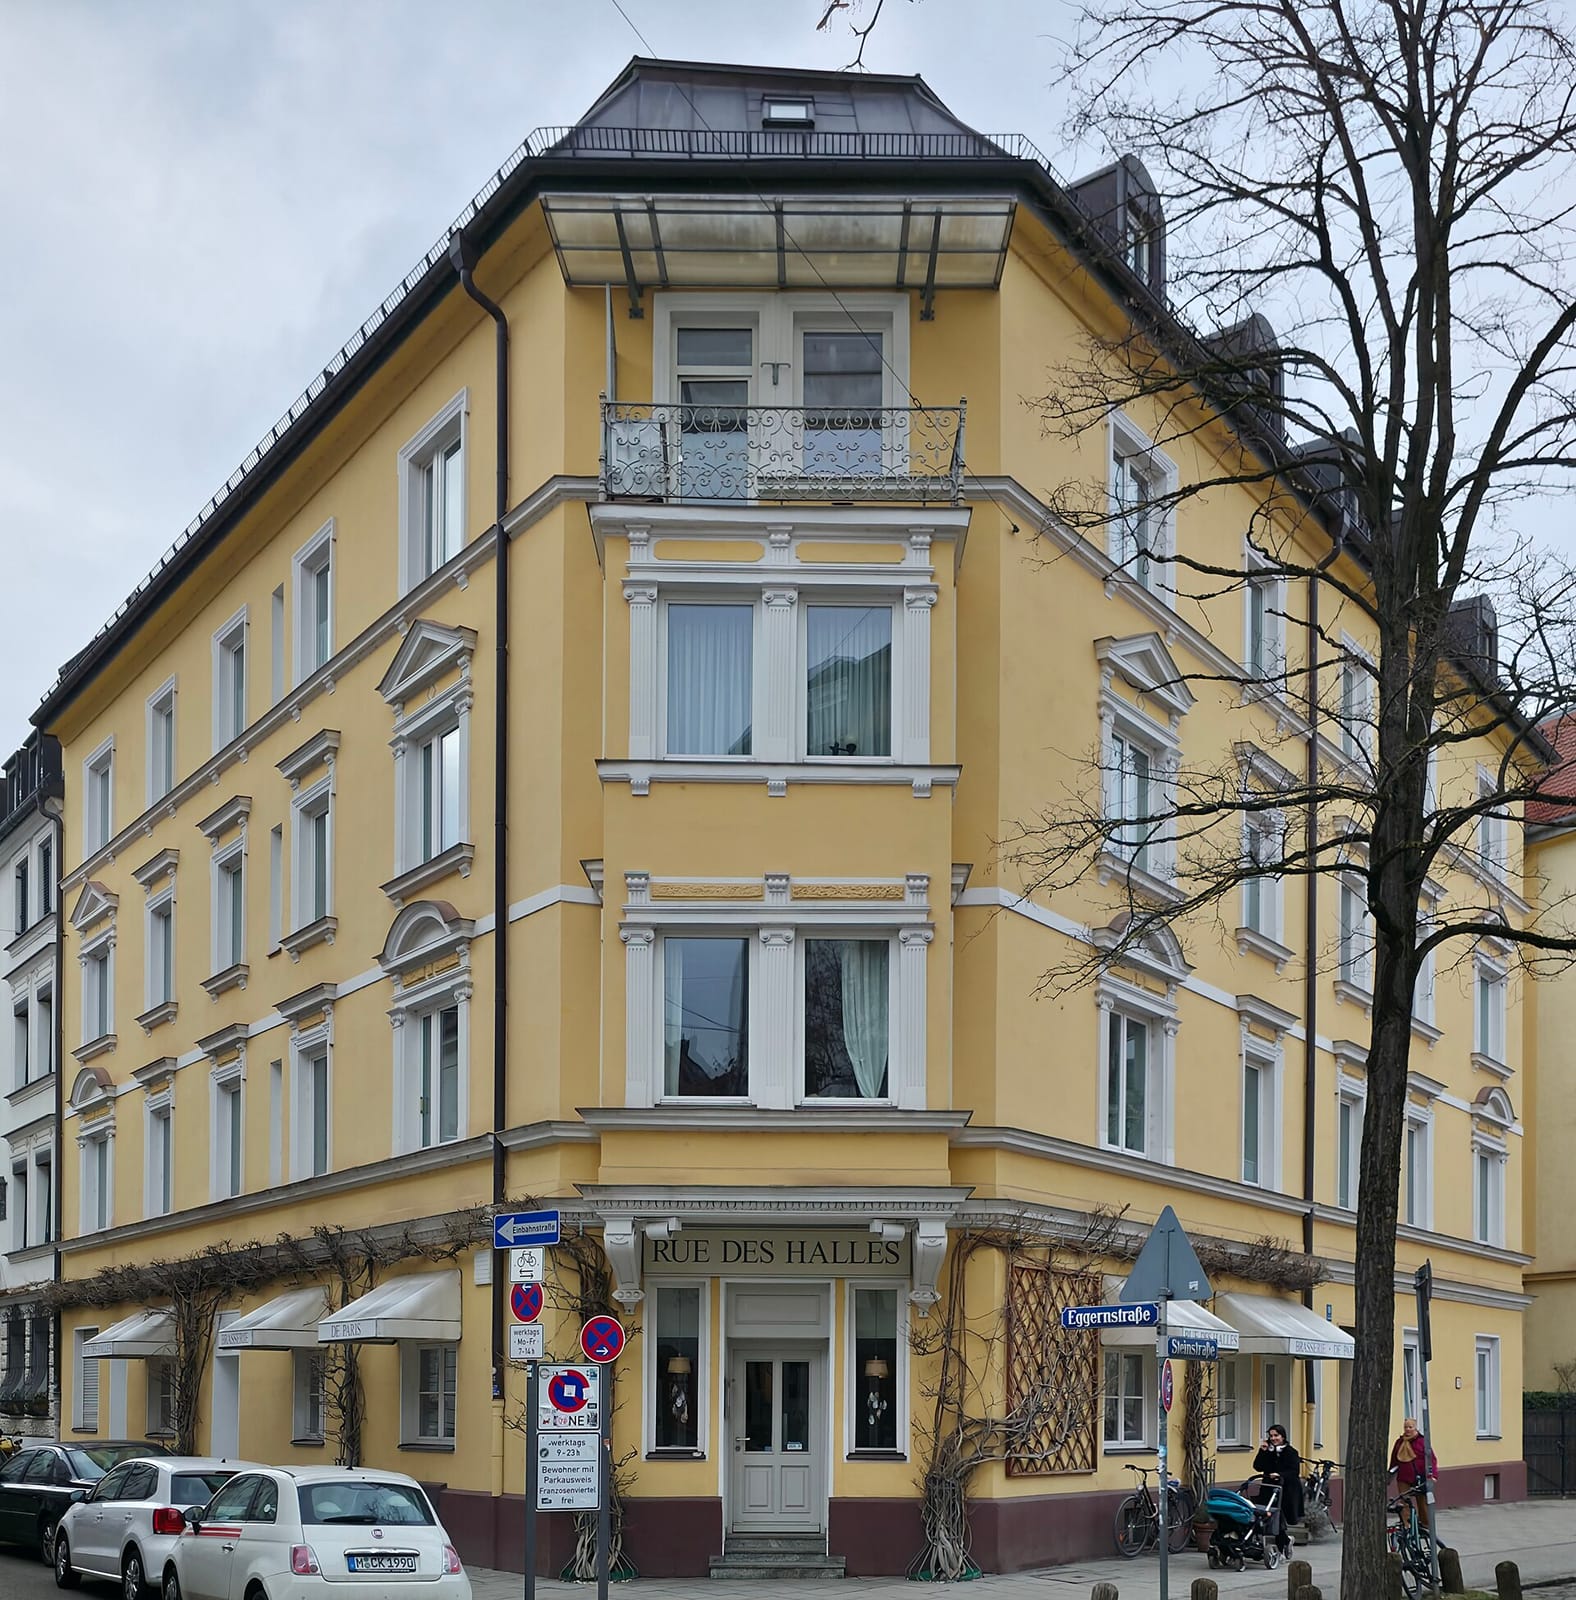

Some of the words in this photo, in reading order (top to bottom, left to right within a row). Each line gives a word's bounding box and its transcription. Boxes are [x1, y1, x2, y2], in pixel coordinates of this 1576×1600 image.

[513, 1223, 555, 1234] Einbahnstraße
[653, 1239, 710, 1263] RUE
[720, 1239, 774, 1264] DES
[785, 1240, 900, 1265] HALLES
[1068, 1306, 1151, 1327] Eggernstraße
[331, 1324, 341, 1338] DE
[342, 1322, 362, 1337] PARIS
[513, 1329, 540, 1337] werktags
[1171, 1338, 1215, 1359] Steinstraße
[550, 1439, 586, 1448] werktags
[541, 1466, 581, 1474] Bewohner
[582, 1465, 594, 1473] mit
[543, 1476, 592, 1484] Parkausweis
[539, 1487, 596, 1495] Franzosenviertel
[561, 1496, 574, 1505] frei
[356, 1557, 364, 1568] M
[370, 1557, 385, 1568] CK
[387, 1557, 414, 1568] 1990
